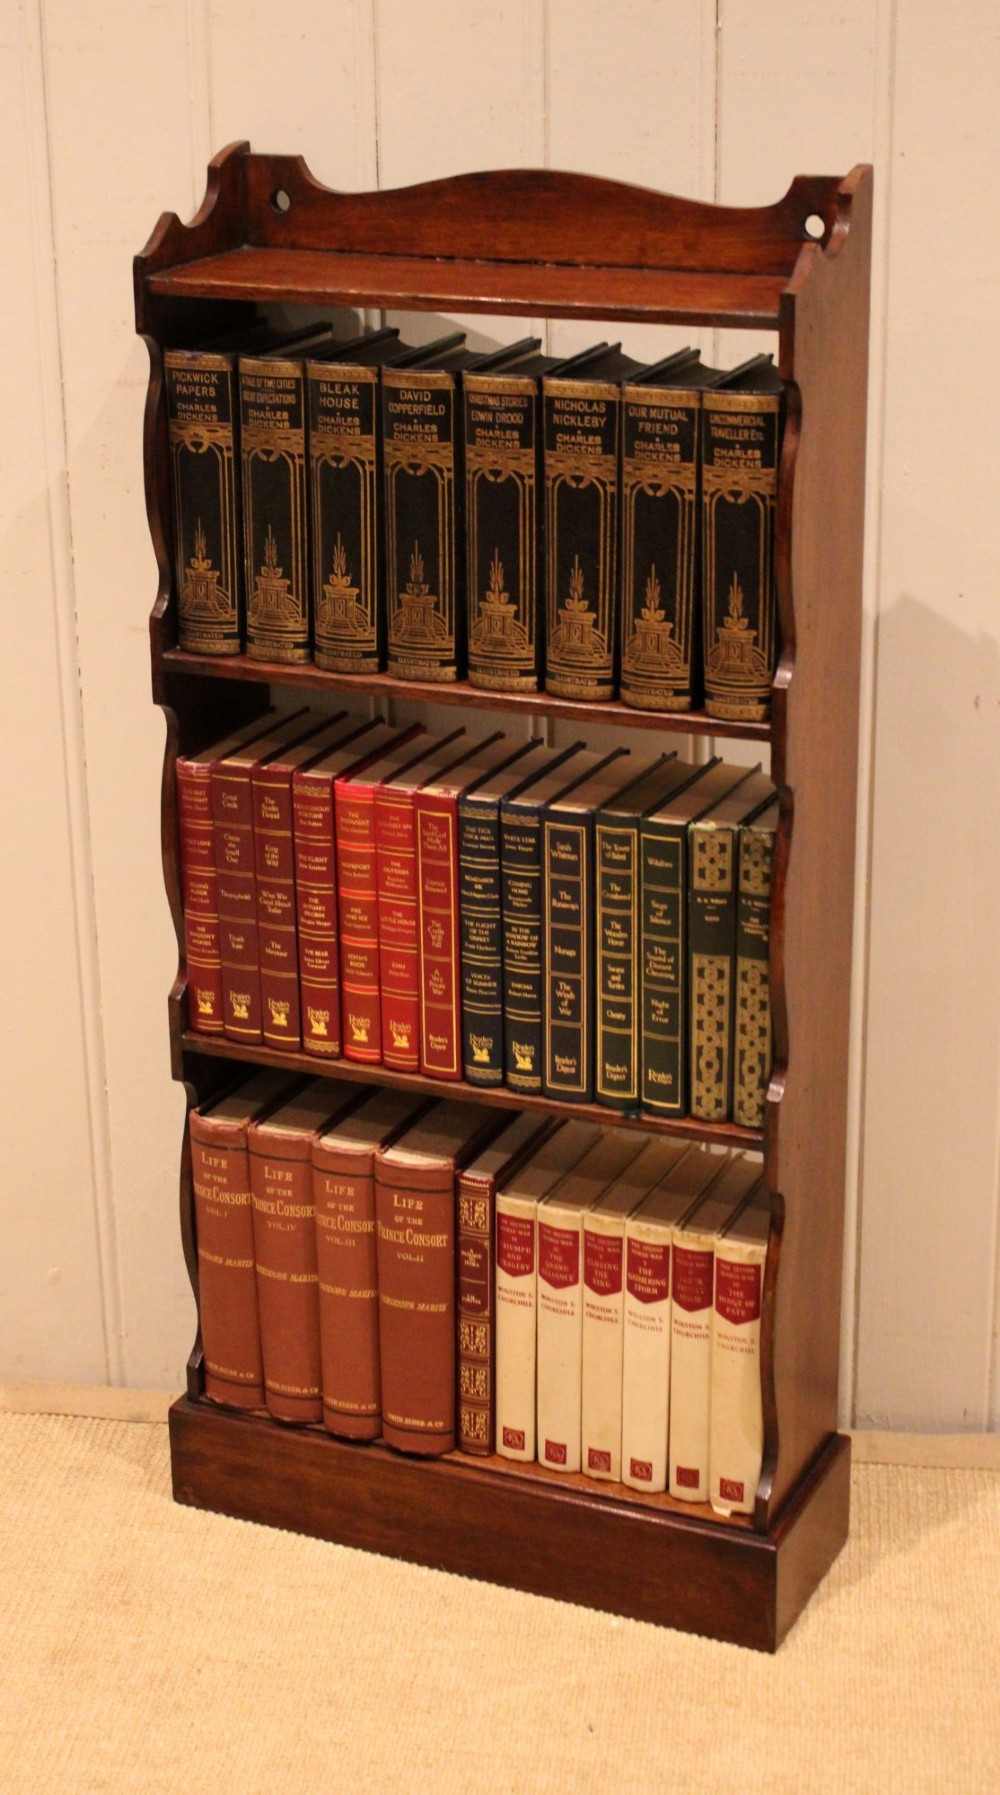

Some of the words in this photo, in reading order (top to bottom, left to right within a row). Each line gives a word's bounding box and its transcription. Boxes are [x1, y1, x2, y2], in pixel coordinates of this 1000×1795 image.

[172, 371, 218, 384] PICKWICK
[176, 384, 216, 397] PAPERS
[320, 383, 360, 395] BLEAK
[400, 390, 431, 401] DAVID
[177, 403, 216, 412] CHARLES
[320, 397, 359, 409] HOUSE
[555, 400, 606, 413] NICHOLAS
[248, 409, 289, 420] CHARLES
[389, 404, 445, 415] COPPERFIELD
[628, 406, 648, 418] OUR
[650, 408, 688, 421] MUTUAL
[178, 412, 218, 422] DICKENS
[318, 415, 360, 426] CHARLES
[472, 411, 492, 423] EDWIN
[496, 413, 523, 424] DROOD
[553, 415, 607, 428] NICKLEBY
[710, 414, 765, 426] UNCOMMERCIAL
[249, 419, 290, 429] DICKENS
[393, 423, 438, 433] CHARLES
[638, 421, 678, 435] FRIEND
[318, 425, 360, 435] DICKENS
[476, 428, 519, 439] CHARLES
[393, 432, 438, 442] DICKENS
[557, 434, 602, 444] CHARLES
[476, 438, 520, 448] DICKENS
[634, 441, 680, 452] CHARLES
[557, 444, 602, 454] DICKENS
[714, 448, 761, 458] CHARLES
[634, 451, 681, 463] DICKENS
[714, 458, 762, 468] DICKENS
[556, 989, 575, 999] Winds
[652, 999, 669, 1009] Night
[201, 1152, 227, 1169] LIFE
[264, 1166, 292, 1181] LIFE
[325, 1181, 354, 1196] LIFE
[394, 1194, 423, 1210] LIFE
[378, 1220, 404, 1243] PRINCE
[406, 1228, 448, 1247] CONSORT
[587, 1258, 618, 1271] CLOSING
[634, 1284, 658, 1294] STORM
[498, 1295, 532, 1307] CHURCHILL
[719, 1295, 743, 1306] HINGE
[541, 1303, 574, 1316] CHURCHILL
[726, 1307, 746, 1317] FATE
[586, 1312, 618, 1323] CHURCHILL
[628, 1319, 663, 1332] CHURCHILL
[674, 1317, 702, 1330] WINSTON
[674, 1328, 710, 1340] CHURCHILL
